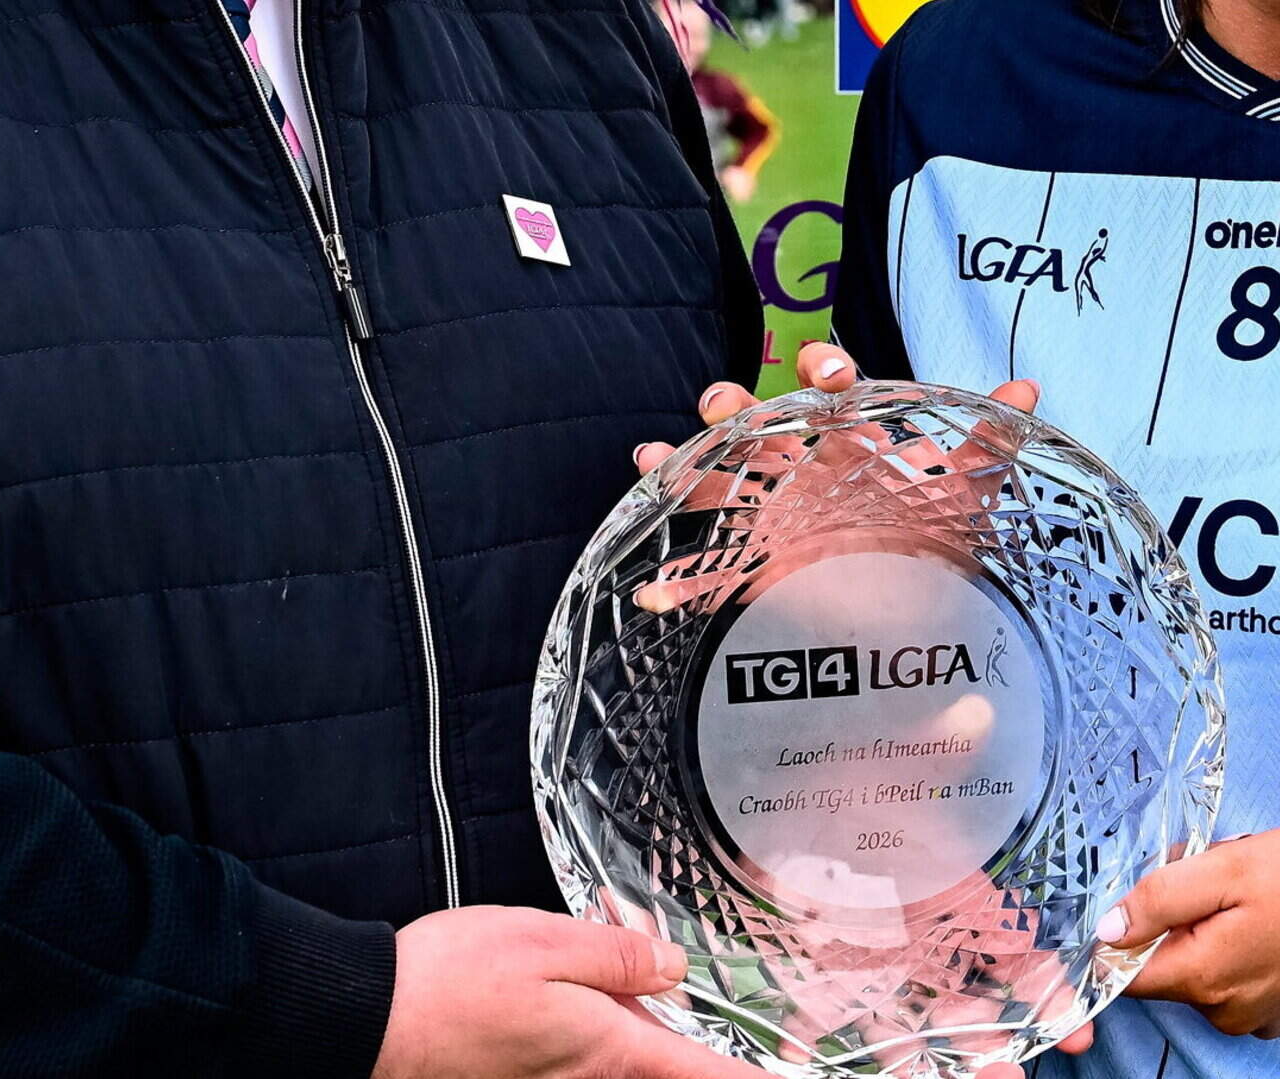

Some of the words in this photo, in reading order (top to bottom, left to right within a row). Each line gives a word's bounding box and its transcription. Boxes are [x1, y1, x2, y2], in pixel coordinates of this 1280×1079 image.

[957, 234, 1070, 292] LGFA
[733, 653, 851, 698] TG4
[870, 644, 981, 690] LGFA
[776, 742, 835, 766] Laoch
[842, 747, 866, 761] na
[739, 789, 807, 815] Craobh
[812, 787, 854, 814] TG4
[874, 780, 925, 804] bPeil
[958, 777, 1015, 798] mBan
[856, 829, 905, 851] 2026
